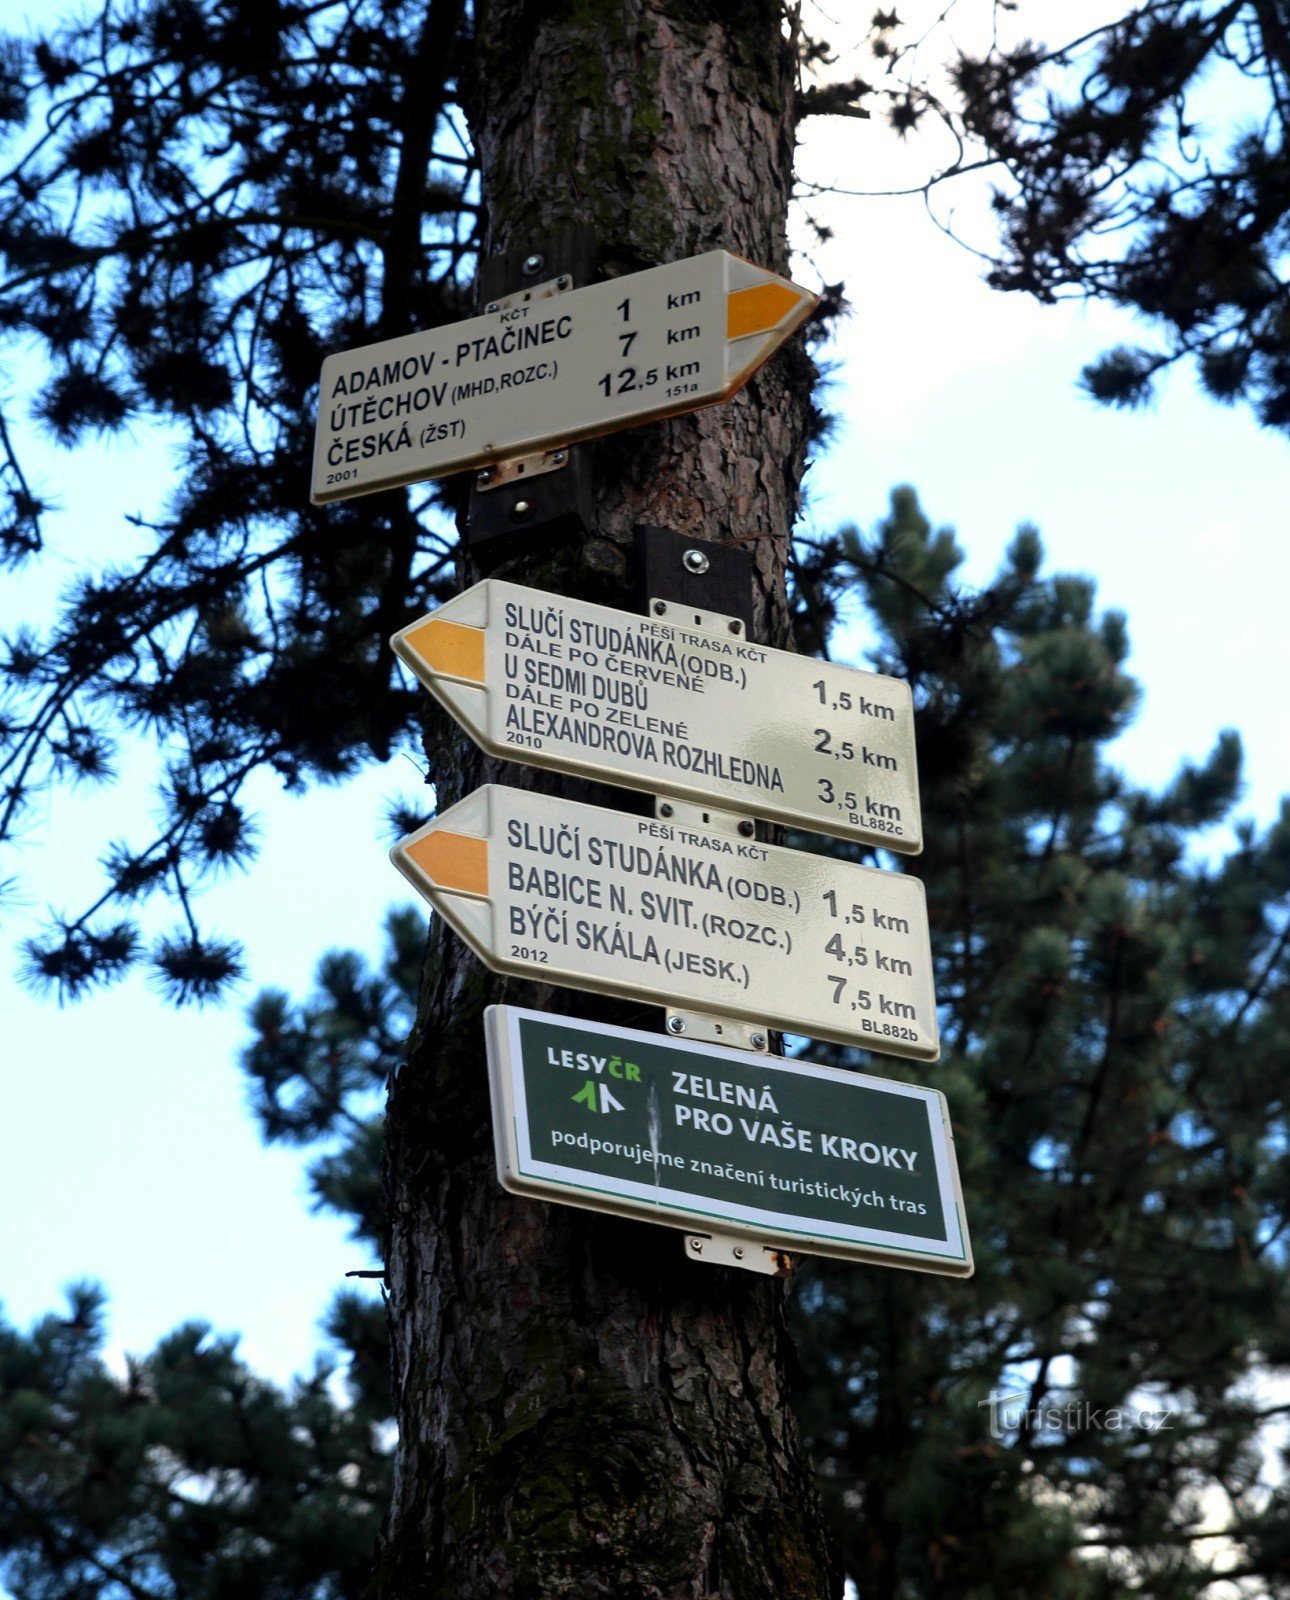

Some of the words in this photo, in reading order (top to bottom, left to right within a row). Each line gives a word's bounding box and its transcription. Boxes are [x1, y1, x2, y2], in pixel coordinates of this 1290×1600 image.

[332, 358, 436, 398] ADAMOV
[455, 315, 572, 368] PTAČINEC
[616, 299, 631, 322] 1
[667, 291, 701, 310] km
[500, 307, 530, 324] KČT
[330, 383, 447, 432] ÚTĚCHOV
[619, 333, 636, 358] 7
[667, 325, 701, 344] km
[665, 382, 698, 398] 151a
[327, 426, 413, 467] ČESKÁ
[420, 420, 466, 449] (ŽST)
[599, 368, 658, 397] 12,5
[666, 360, 700, 380] km
[327, 469, 358, 484] 2001
[505, 602, 564, 639] SLUČÍ
[813, 680, 852, 711] 1,5
[860, 696, 895, 721] km
[506, 631, 563, 657] DÁLE
[569, 648, 598, 667] PO
[606, 654, 705, 694] ČERVENÉ
[640, 622, 675, 641] PĚŠÍ
[679, 633, 734, 656] TRASA
[737, 646, 768, 664] KČT
[505, 655, 517, 679] U
[525, 658, 587, 696] SEDMI
[593, 676, 649, 711] DUBŮ
[813, 729, 854, 760] 2,5
[863, 746, 898, 771] km
[506, 683, 563, 709] DÁLE
[570, 699, 599, 718] PO
[606, 708, 688, 740] ZELENÉ
[507, 732, 542, 749] 2010
[506, 704, 658, 762] ALEXANDROVA
[663, 740, 785, 793] ROZHLEDNA
[818, 778, 857, 810] 3,5
[865, 796, 900, 821] km
[638, 822, 674, 841] PĚŠÍ
[678, 832, 733, 855] TRASA
[736, 844, 769, 862] KČT
[508, 819, 580, 861] SLUČÍ
[587, 839, 721, 892] STUDÁNKA
[727, 877, 800, 914] (ODB.)
[823, 889, 865, 924] 1,5
[873, 907, 909, 934] km
[508, 862, 601, 908] BABICE
[610, 886, 633, 916] N.
[824, 933, 868, 967] 4,5
[876, 949, 913, 976] km
[509, 905, 568, 946] BÝČÍ
[576, 919, 659, 964] SKÁLA
[664, 949, 751, 989] (JESK.)
[827, 974, 871, 1010] 7,5
[880, 992, 916, 1021] km
[511, 945, 548, 964] 2012
[862, 1019, 919, 1042] BL882b
[672, 1071, 779, 1114] ZELENÁ
[675, 1105, 734, 1136] PRO
[739, 1120, 814, 1152] VAŠE
[821, 1136, 918, 1172] KROKY
[551, 1129, 685, 1170] podporujeme
[690, 1156, 764, 1187] značení
[769, 1172, 885, 1209] turistických
[889, 1193, 927, 1216] tras
